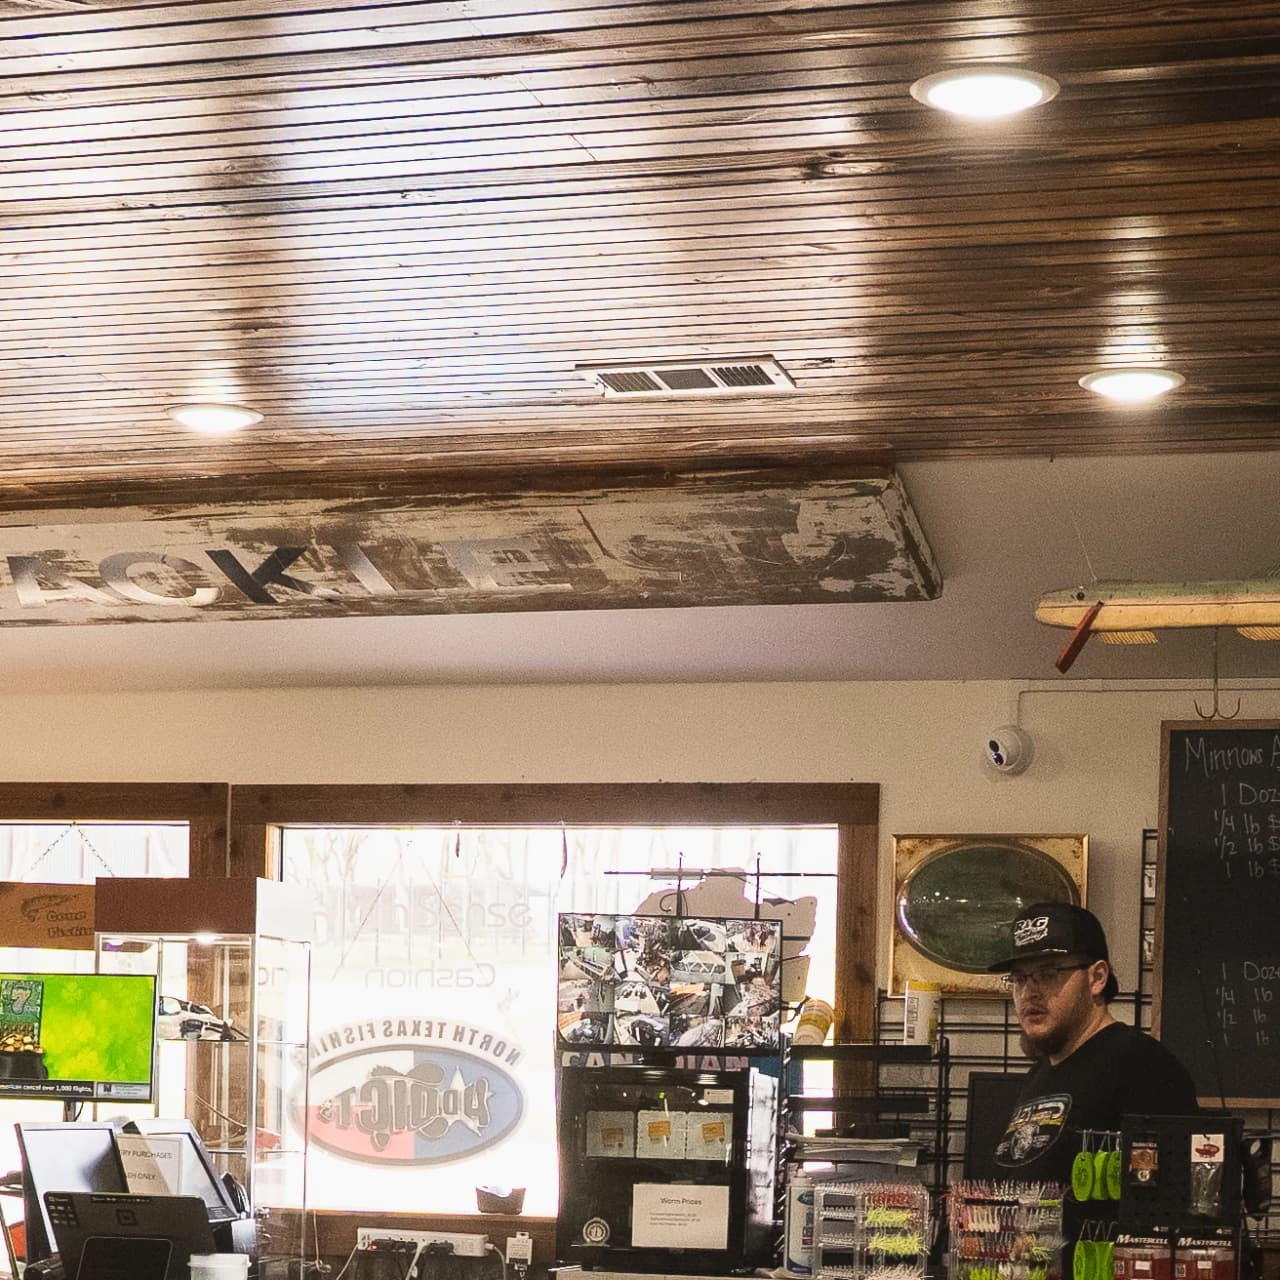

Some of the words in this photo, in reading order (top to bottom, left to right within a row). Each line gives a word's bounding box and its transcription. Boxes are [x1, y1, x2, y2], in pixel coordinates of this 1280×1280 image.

[1214, 809, 1236, 836] 1/4
[1244, 813, 1260, 834] lb
[1214, 835, 1238, 859] 1/2
[1248, 837, 1263, 855] lb
[1248, 861, 1264, 878] lb
[9, 986, 31, 1015] 7
